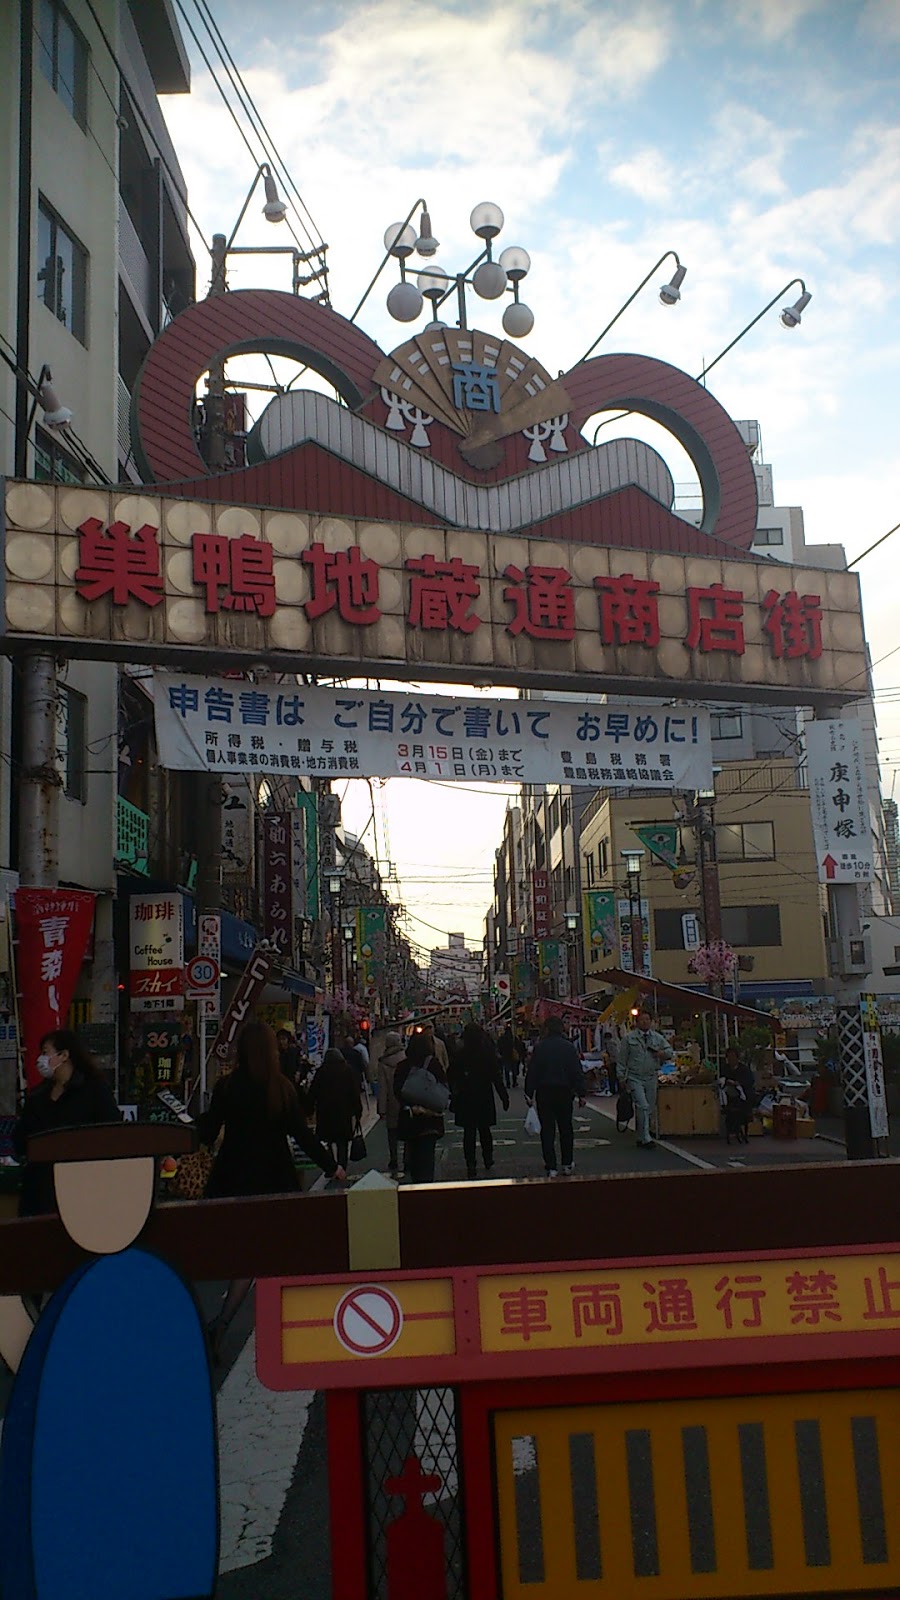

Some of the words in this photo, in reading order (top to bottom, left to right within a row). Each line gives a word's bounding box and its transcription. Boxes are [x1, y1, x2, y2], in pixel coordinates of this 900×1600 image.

[451, 363, 501, 414] 商
[75, 517, 824, 660] 巣鴨地蔵通商店街
[168, 683, 306, 727] 申告書は
[333, 698, 552, 739] ご自分で書いて
[576, 711, 699, 744] お早めに!
[560, 750, 672, 767] 豊島税務署
[563, 766, 675, 782] 豊島税務連絡協議会
[828, 761, 858, 839] 庚申塚
[840, 861, 871, 870] 徒歩10分
[134, 901, 175, 922] 珈琲
[134, 944, 163, 955] Coffee
[135, 971, 178, 994] スカイ
[193, 965, 212, 980] 30
[498, 1265, 900, 1342] 車両通行禁止
